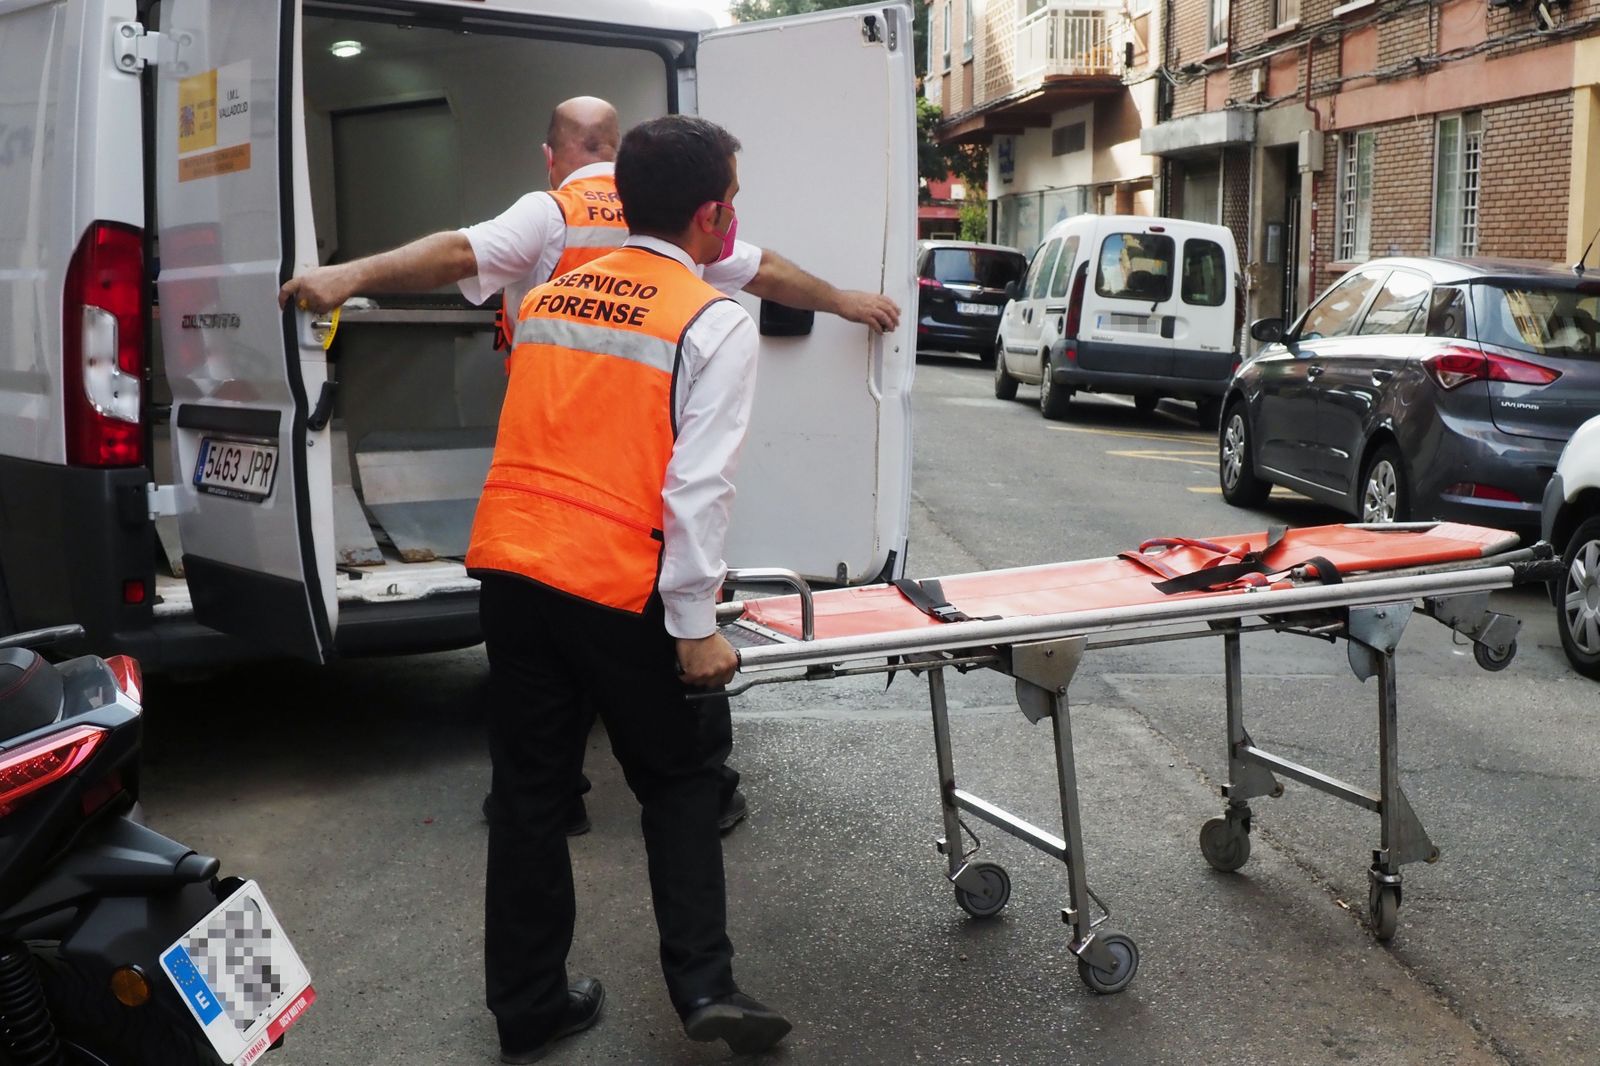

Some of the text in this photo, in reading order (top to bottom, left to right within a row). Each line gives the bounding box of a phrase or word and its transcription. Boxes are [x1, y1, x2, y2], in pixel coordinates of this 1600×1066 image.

[219, 102, 248, 118] VALLADOLID
[554, 273, 658, 300] SERVICIO
[534, 295, 650, 327] FORENSE
[205, 446, 273, 488] 5463 JPR
[195, 990, 211, 1010] E
[288, 996, 308, 1019] MOTOR
[245, 1037, 268, 1063] YAMAHA
